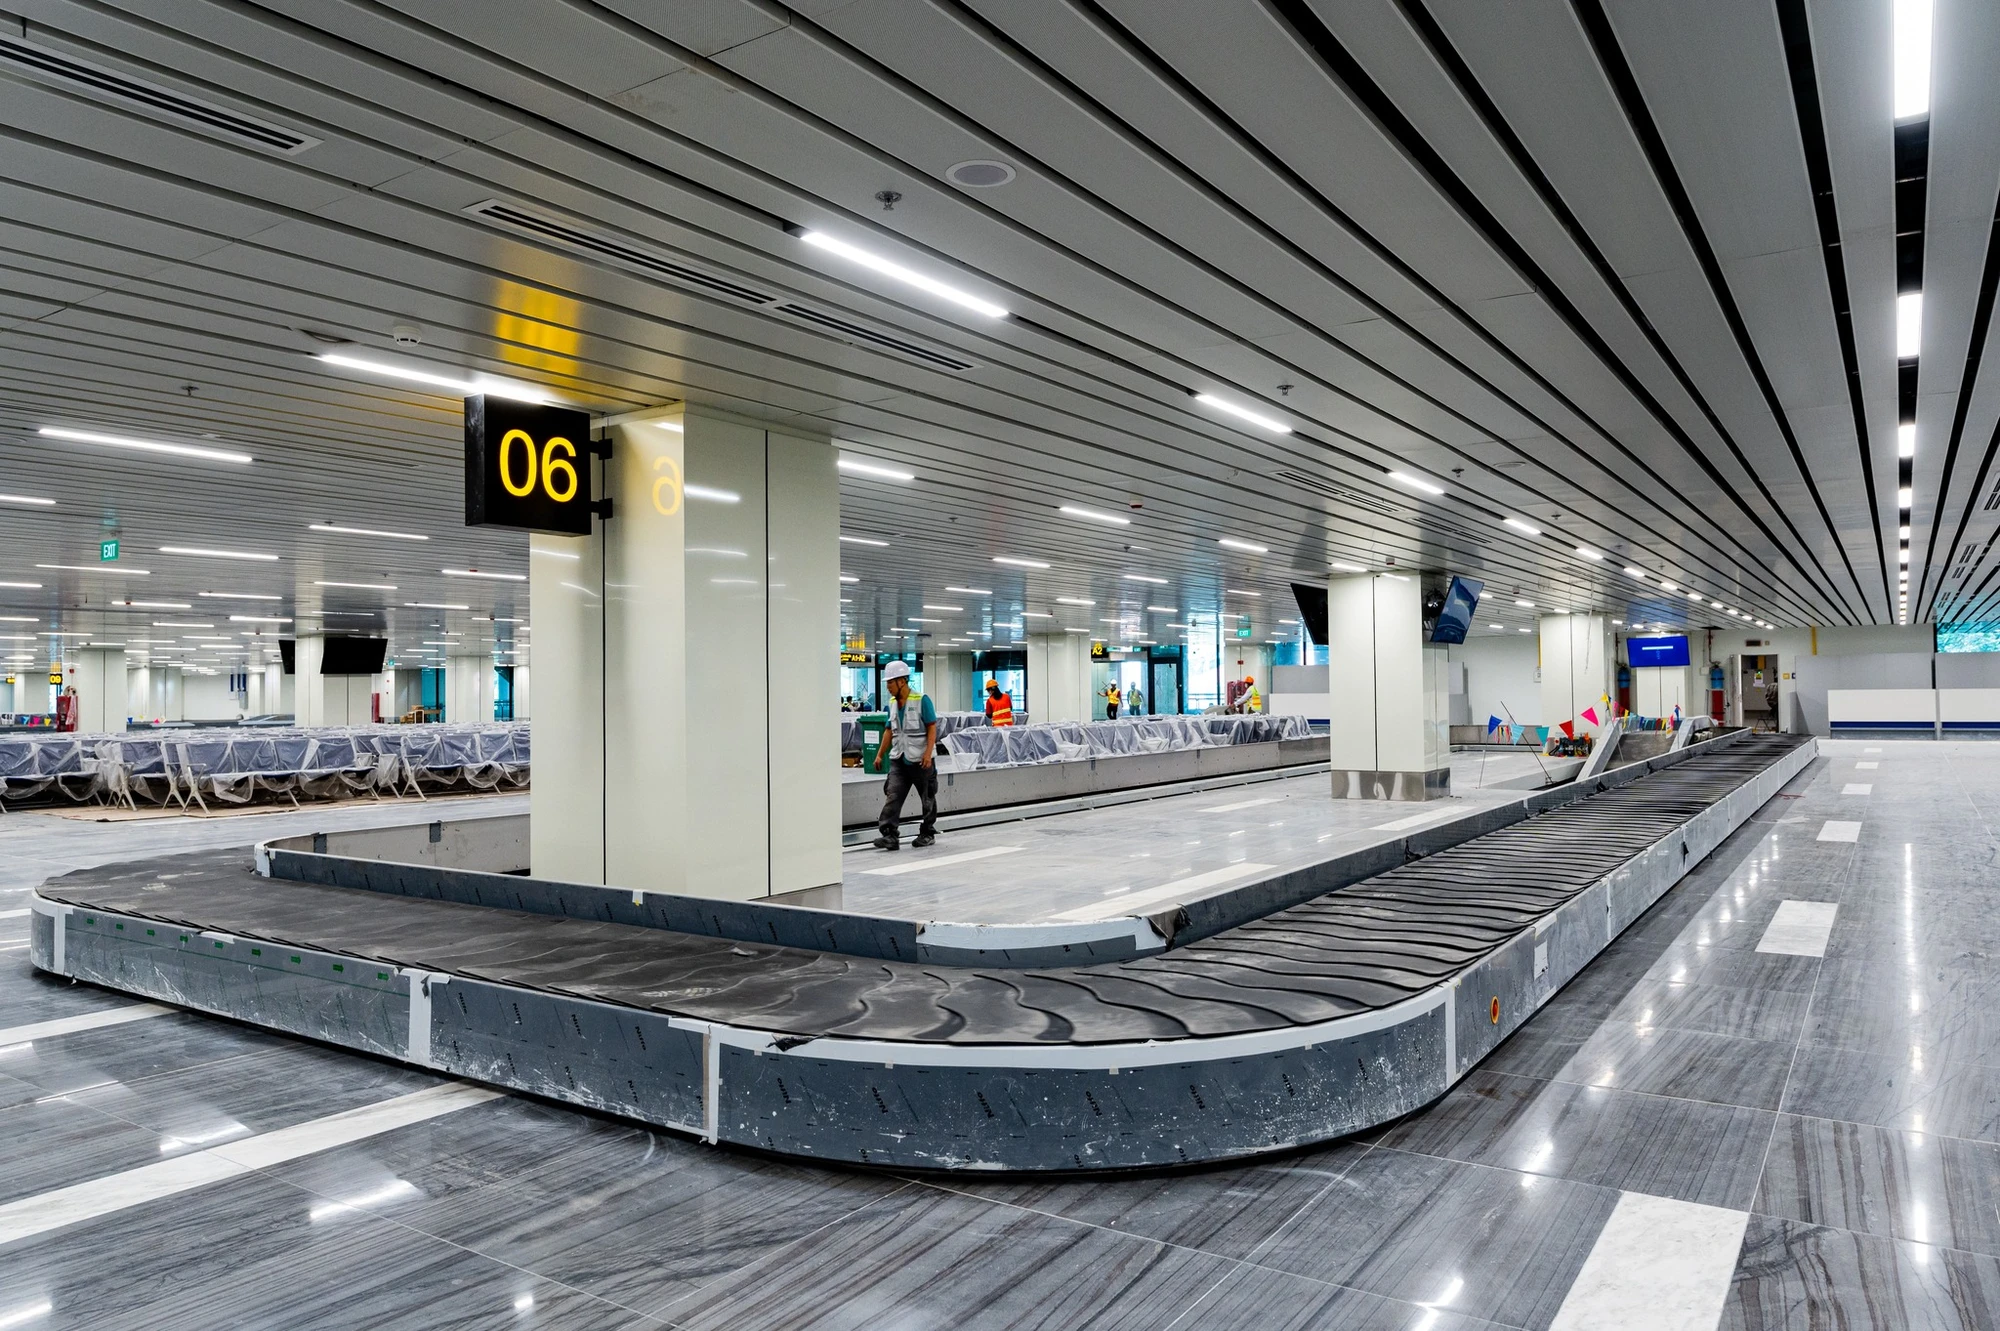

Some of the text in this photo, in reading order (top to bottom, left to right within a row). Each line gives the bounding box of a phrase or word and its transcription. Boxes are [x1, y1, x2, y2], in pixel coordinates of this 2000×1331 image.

[499, 429, 577, 503] 06
[104, 543, 116, 558] EXIT
[1092, 647, 1103, 655] A2
[51, 675, 61, 683] 09
[872, 1087, 888, 1114] Nitto
[977, 1091, 995, 1119] Nitto
[1085, 1091, 1103, 1117] Nitto
[1189, 1084, 1206, 1110] Nitto
